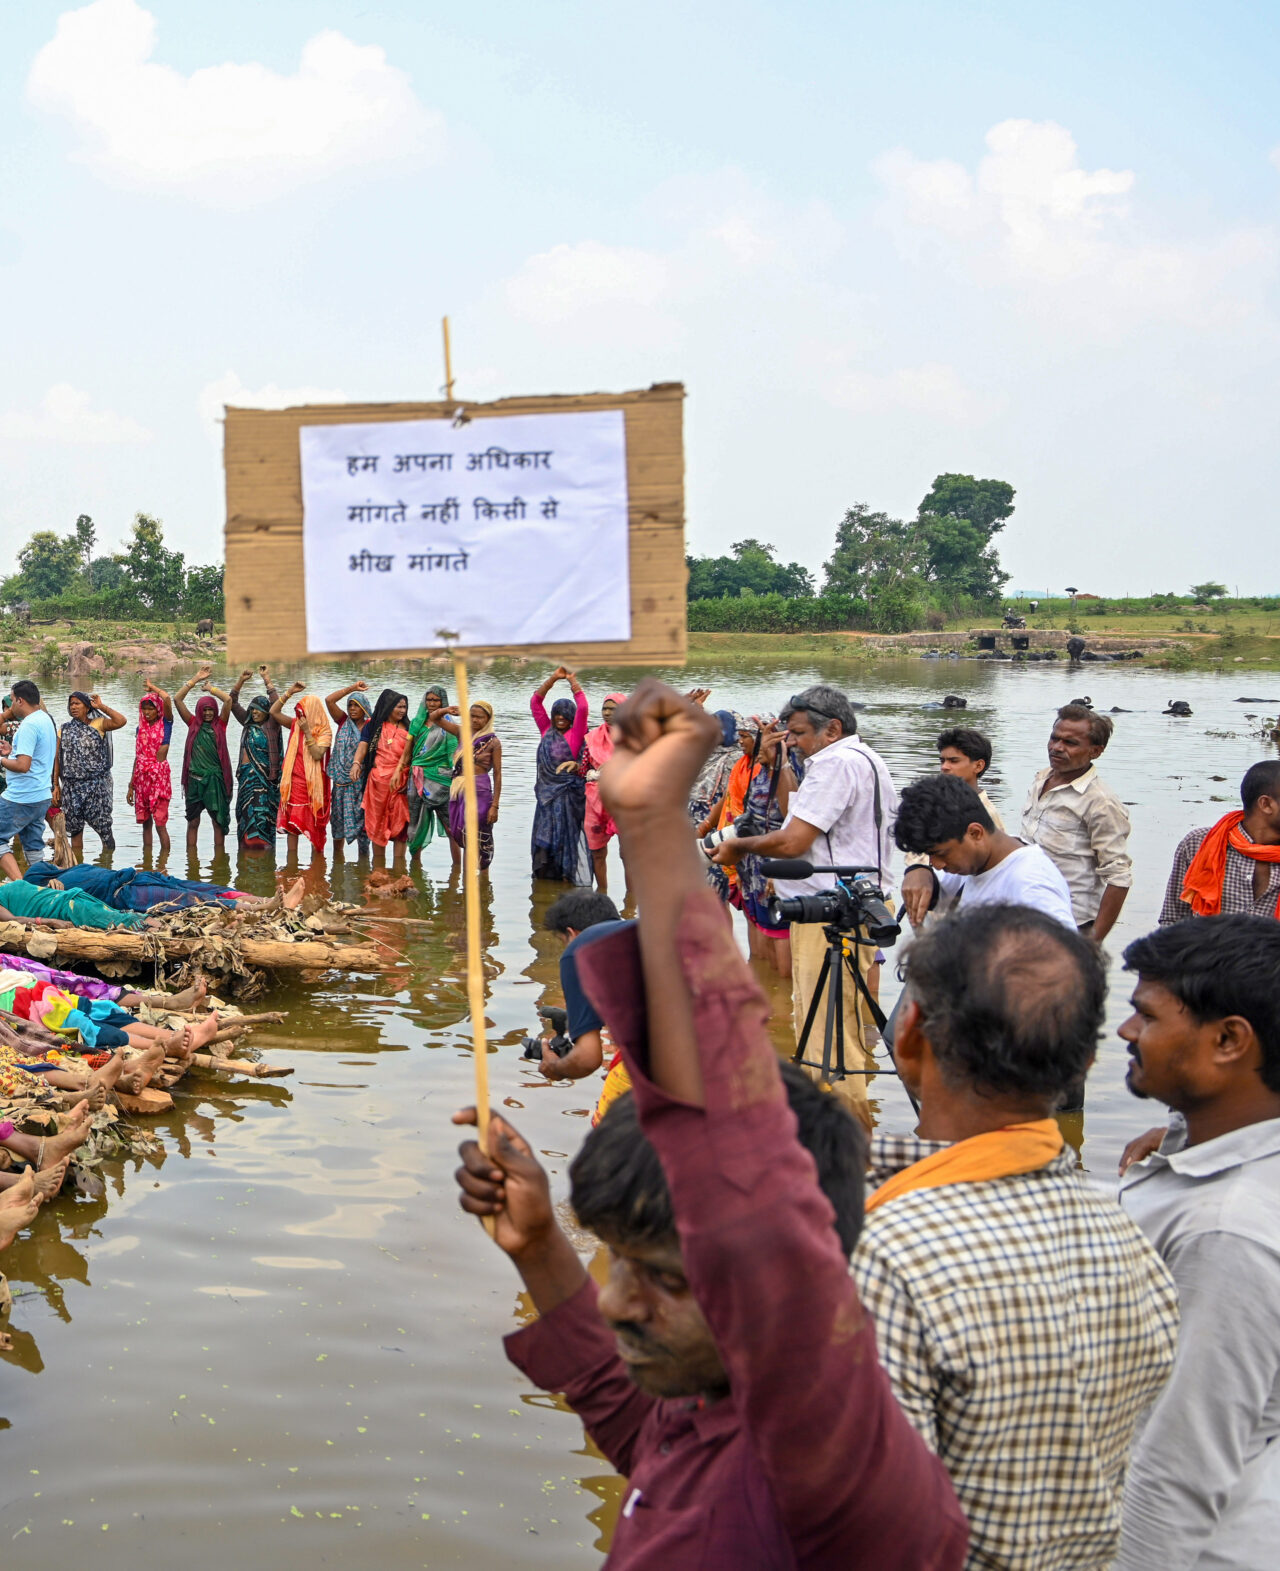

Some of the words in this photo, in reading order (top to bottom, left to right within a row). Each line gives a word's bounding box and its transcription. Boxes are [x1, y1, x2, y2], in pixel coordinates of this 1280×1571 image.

[347, 454, 380, 475] हम
[393, 452, 454, 474] अपना
[466, 445, 554, 472] अधिकार
[347, 498, 408, 524] मांगते
[420, 494, 461, 525] नहीं
[473, 494, 528, 521] किसी
[540, 496, 560, 520] से
[348, 547, 394, 573] भीख
[408, 545, 470, 573] मांगते
